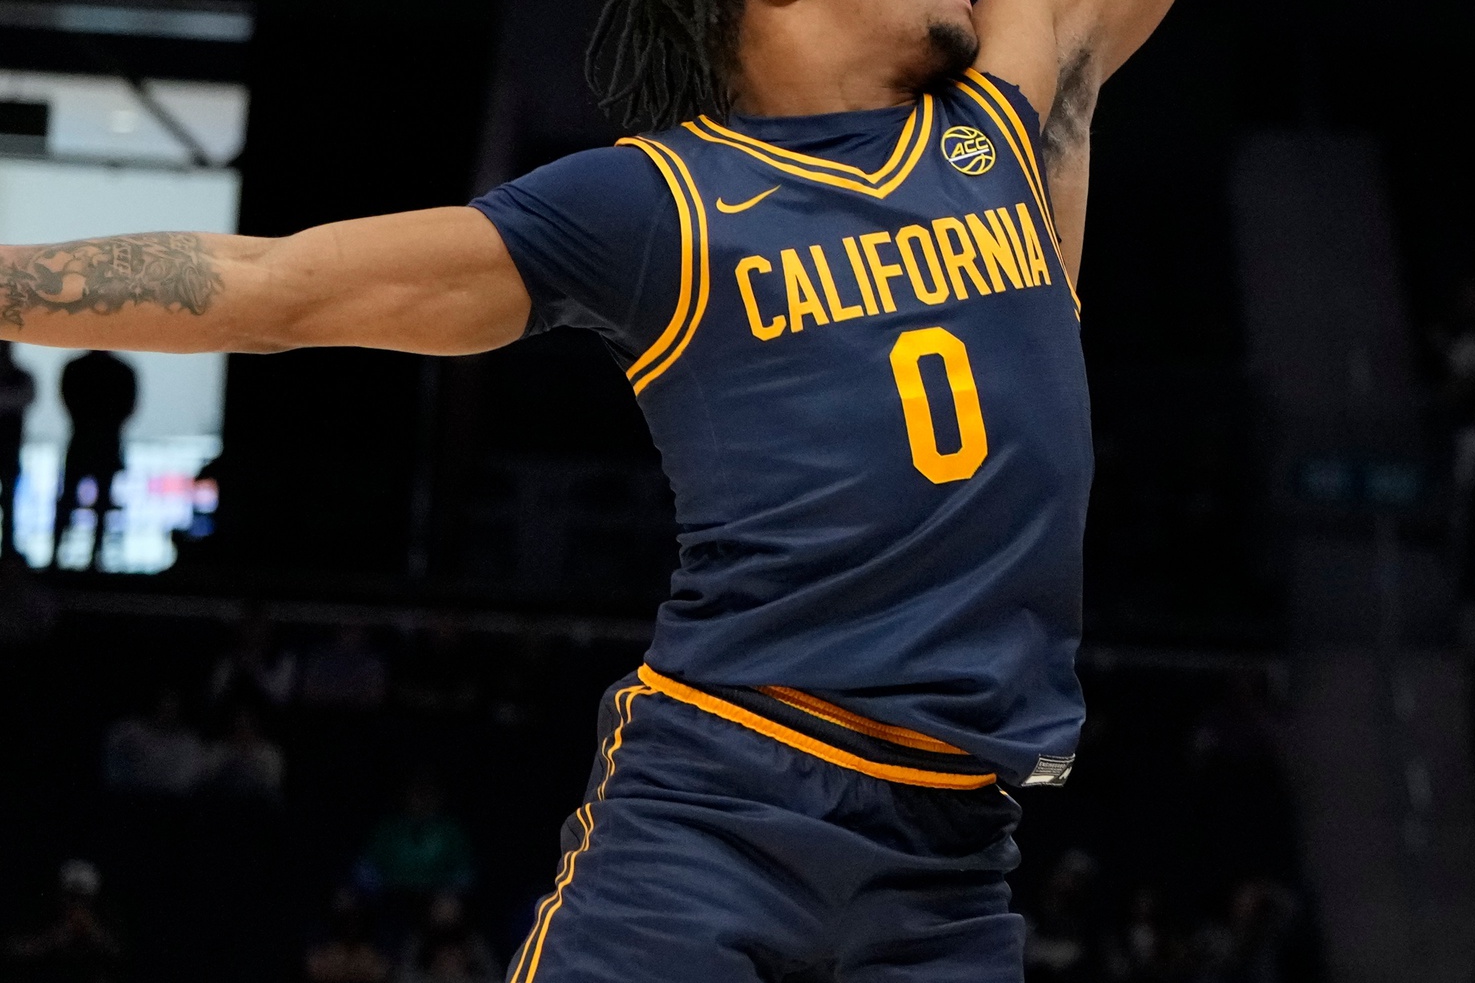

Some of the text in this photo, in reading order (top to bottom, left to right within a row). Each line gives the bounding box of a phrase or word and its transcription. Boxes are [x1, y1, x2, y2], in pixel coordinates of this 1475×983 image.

[950, 136, 989, 158] ACC
[734, 202, 1052, 341] CALIFORNIA
[889, 326, 988, 484] 0
